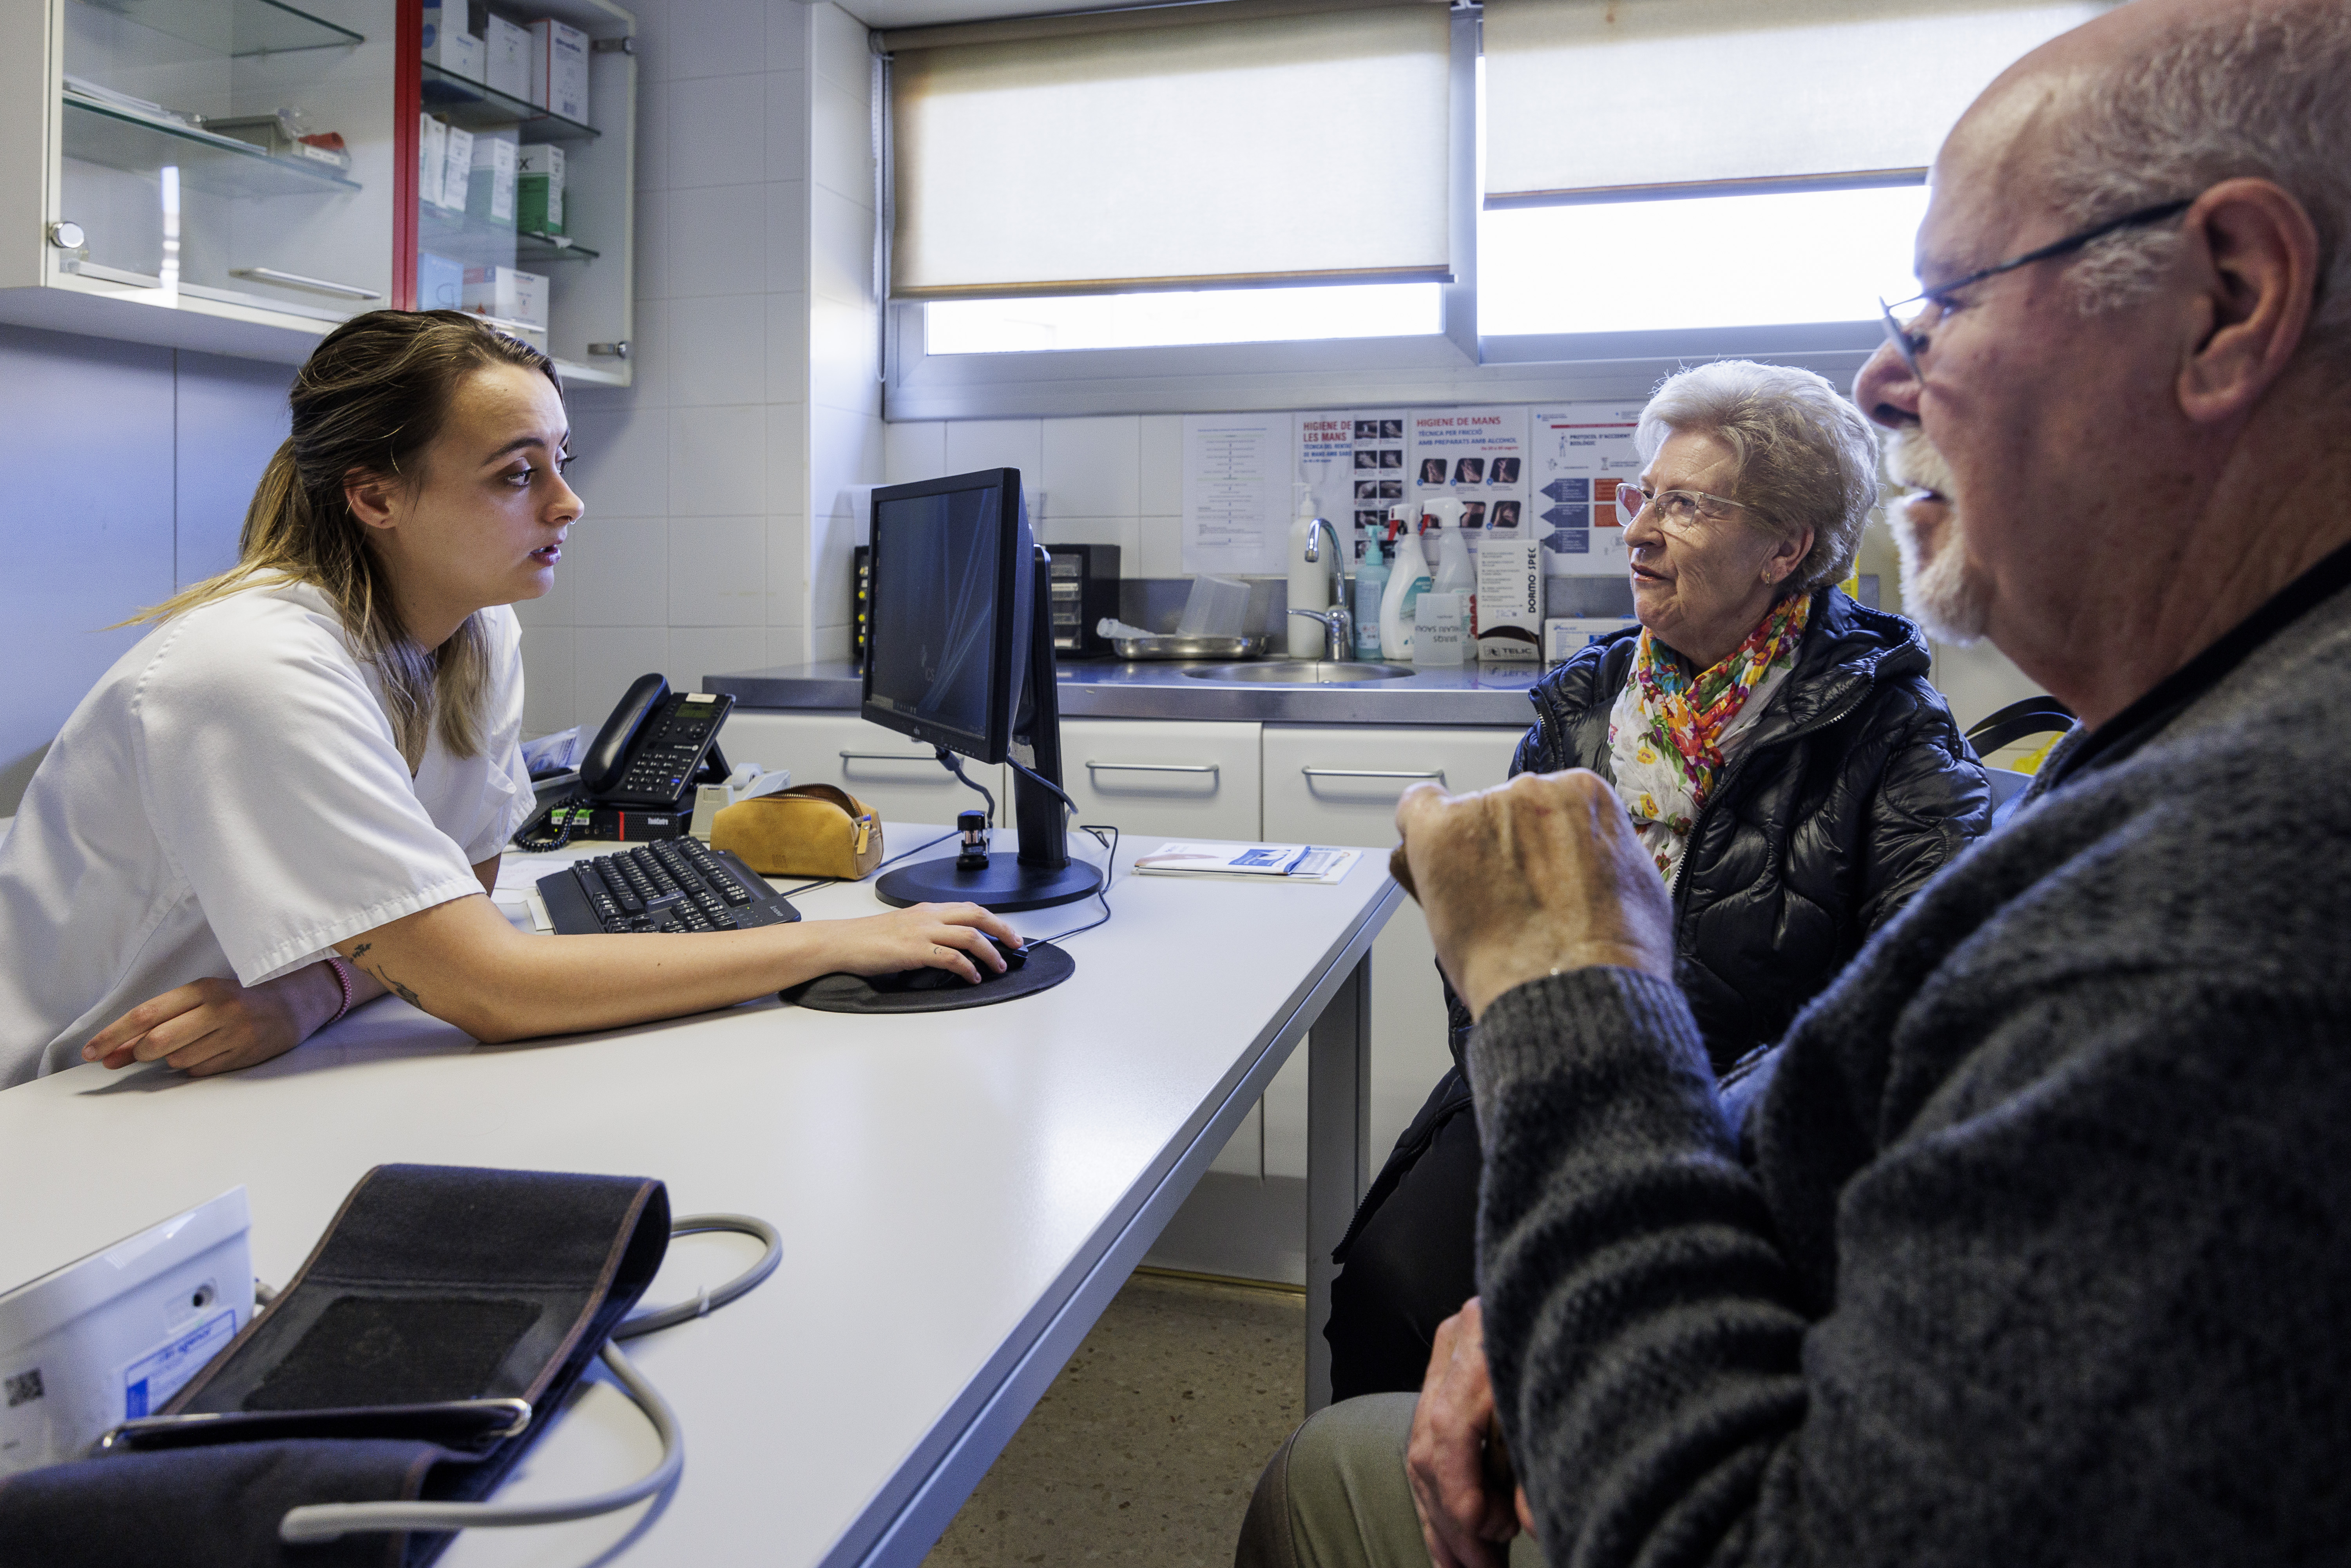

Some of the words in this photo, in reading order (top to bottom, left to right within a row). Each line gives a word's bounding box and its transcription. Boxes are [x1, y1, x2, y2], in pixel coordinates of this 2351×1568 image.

[1303, 421, 1338, 431] HIGIENE
[1340, 420, 1352, 430] DE
[1417, 418, 1454, 427] HIGIENE
[1457, 417, 1469, 426] DE
[1471, 416, 1501, 425] MANS
[1303, 433, 1319, 442] LES
[1321, 432, 1347, 442] MANS
[1528, 547, 1536, 570] SPEC
